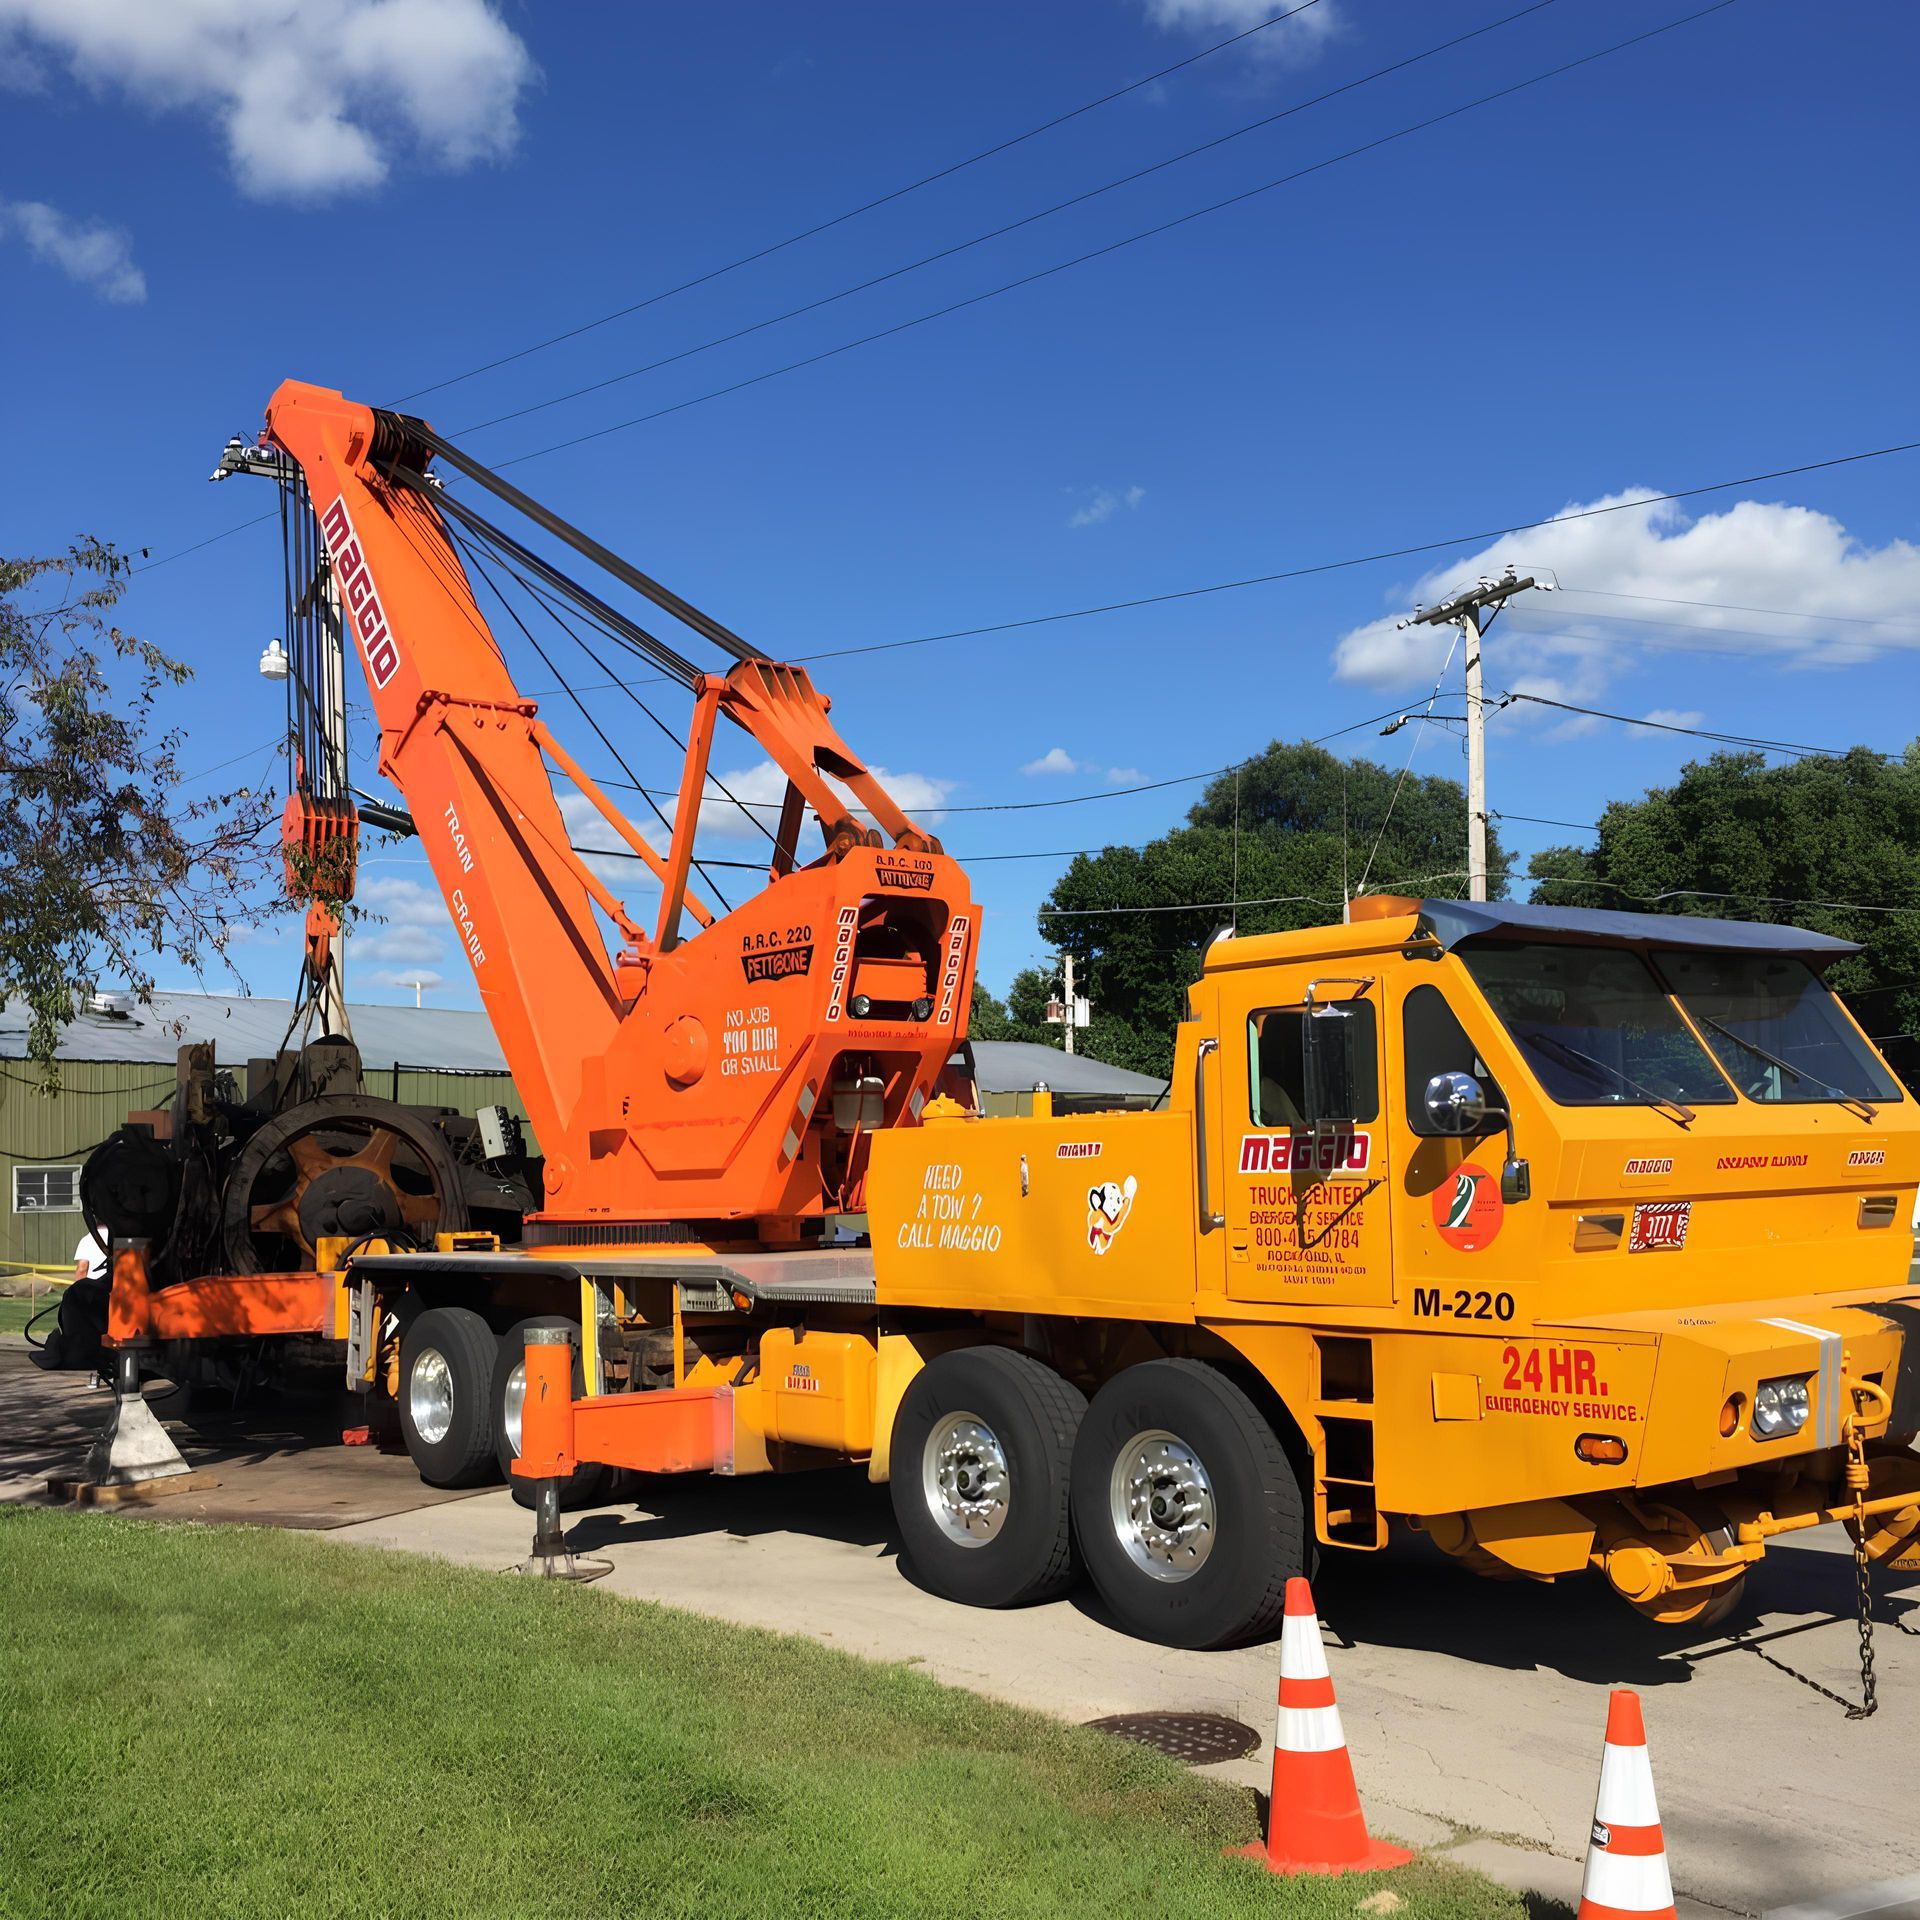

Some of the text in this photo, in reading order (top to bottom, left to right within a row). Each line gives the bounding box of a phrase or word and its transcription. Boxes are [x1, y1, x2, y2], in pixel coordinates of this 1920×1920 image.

[444, 800, 487, 968] TRAIN CRANE
[787, 925, 812, 944] 220
[726, 1006, 770, 1027] NO JOB
[923, 1164, 962, 1190] NEED
[916, 1194, 927, 1219] A
[932, 1194, 966, 1220] TOW
[1249, 1186, 1298, 1206] TRUCK
[898, 1223, 1001, 1252] CALL MAGGIO
[1413, 1287, 1515, 1321] M-220
[1502, 1345, 1609, 1396] 24 HR.
